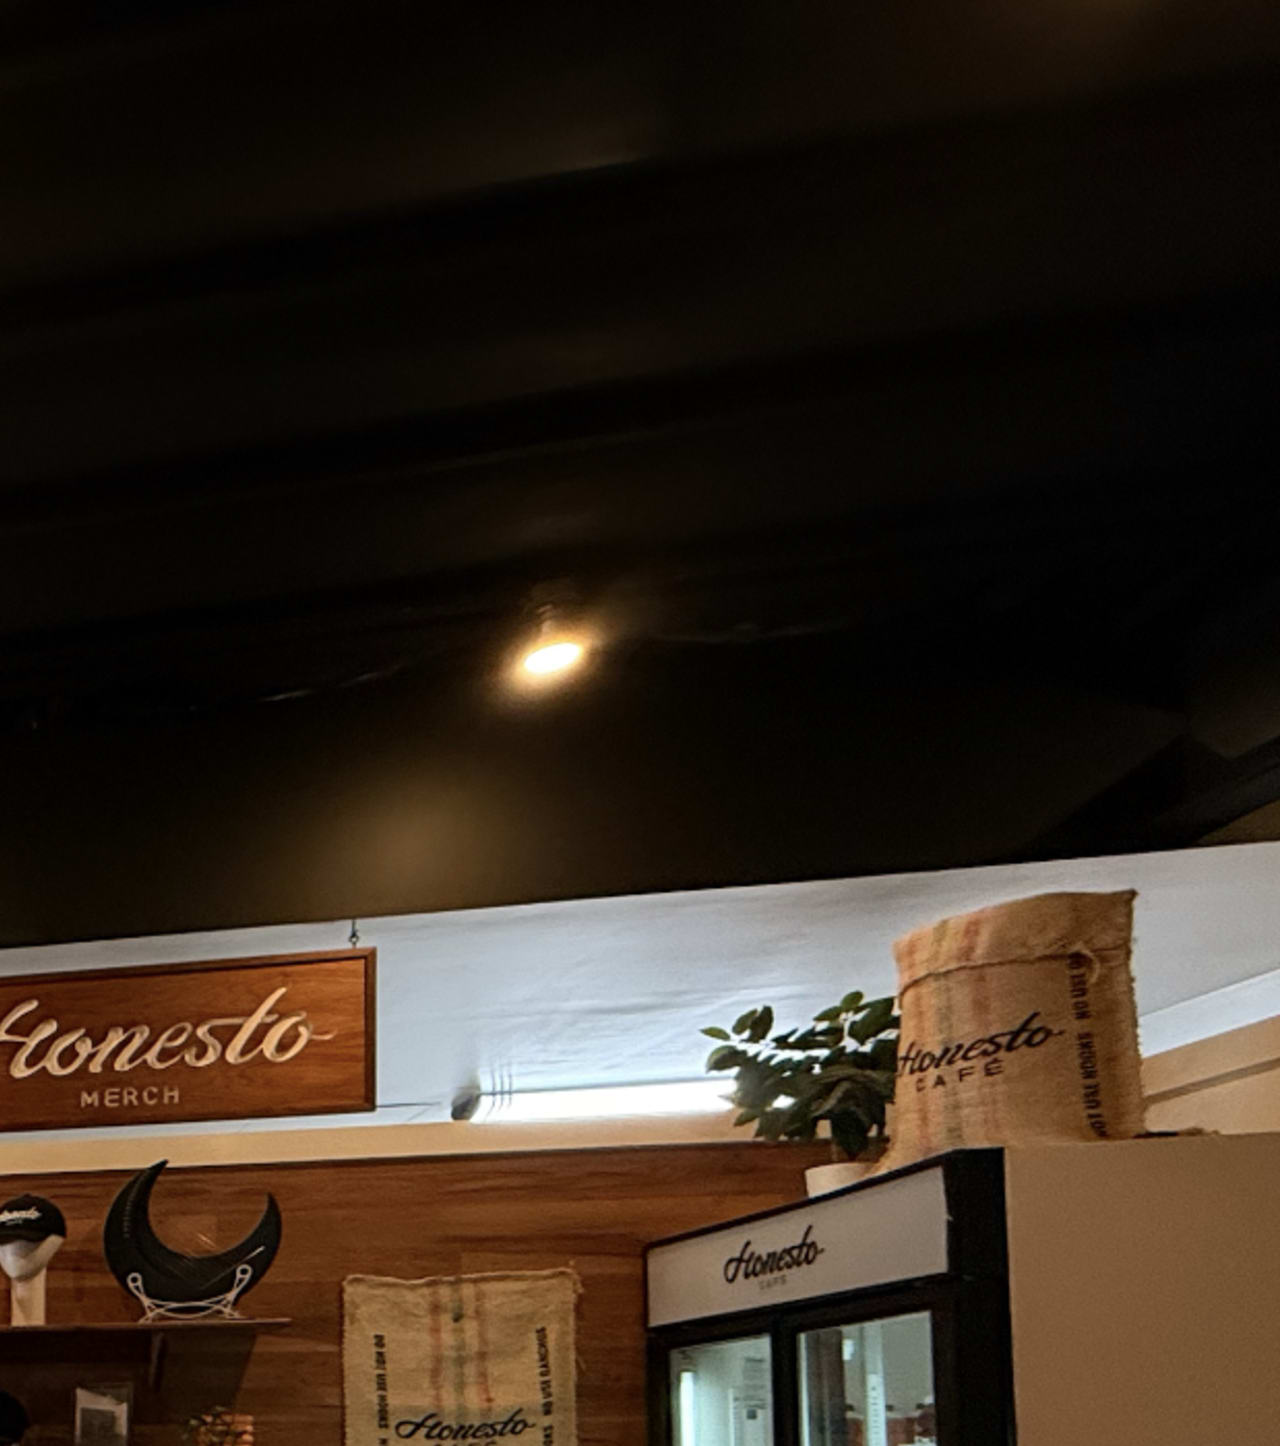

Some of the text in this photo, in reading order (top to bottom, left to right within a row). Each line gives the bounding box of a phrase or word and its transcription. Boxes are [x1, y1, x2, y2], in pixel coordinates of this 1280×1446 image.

[915, 1057, 1005, 1093] CAFÉ
[80, 1086, 181, 1109] MERCH
[723, 1224, 825, 1284] Honesto
[394, 1407, 537, 1441] Honesto
